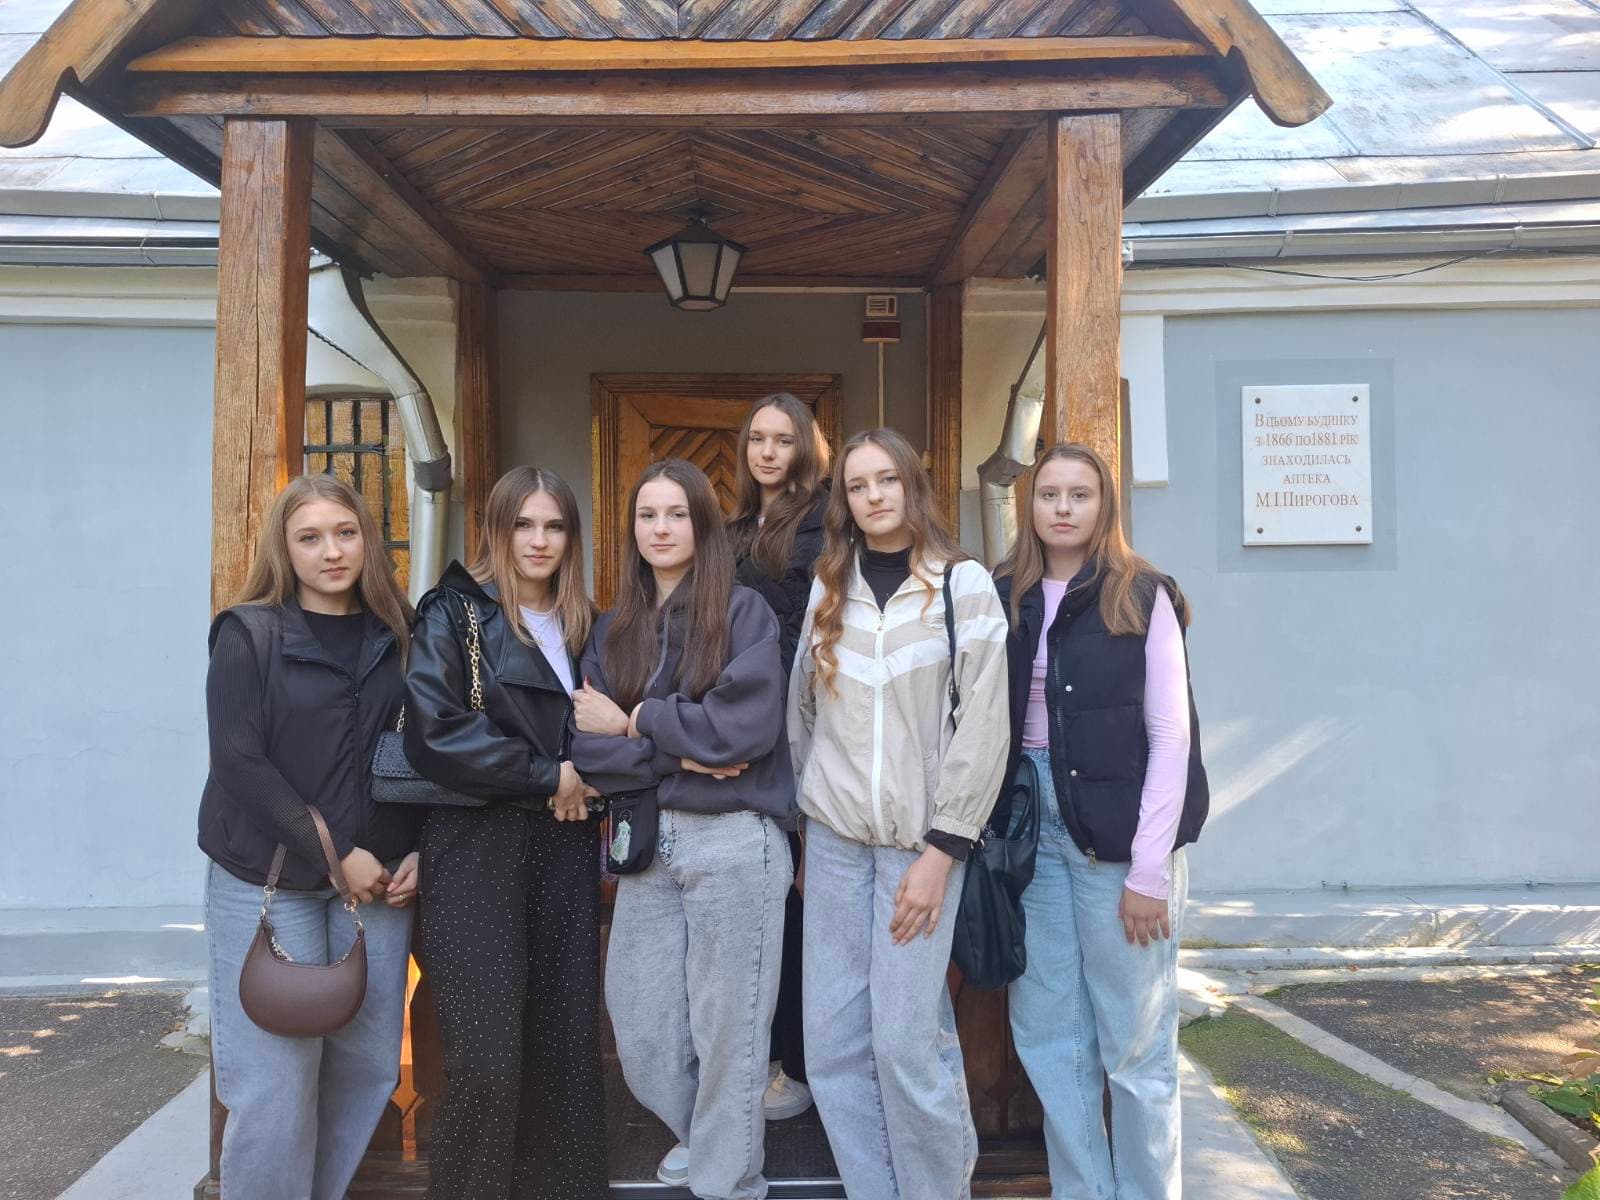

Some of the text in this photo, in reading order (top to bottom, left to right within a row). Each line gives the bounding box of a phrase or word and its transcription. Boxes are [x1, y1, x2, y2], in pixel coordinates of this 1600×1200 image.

[1255, 413, 1264, 427] В
[1266, 433, 1292, 446] 1866
[1340, 434, 1358, 445] РІК
[1262, 455, 1351, 466] ЗНАХОДИЛАСЬ
[1283, 474, 1331, 484] АПТЕКА
